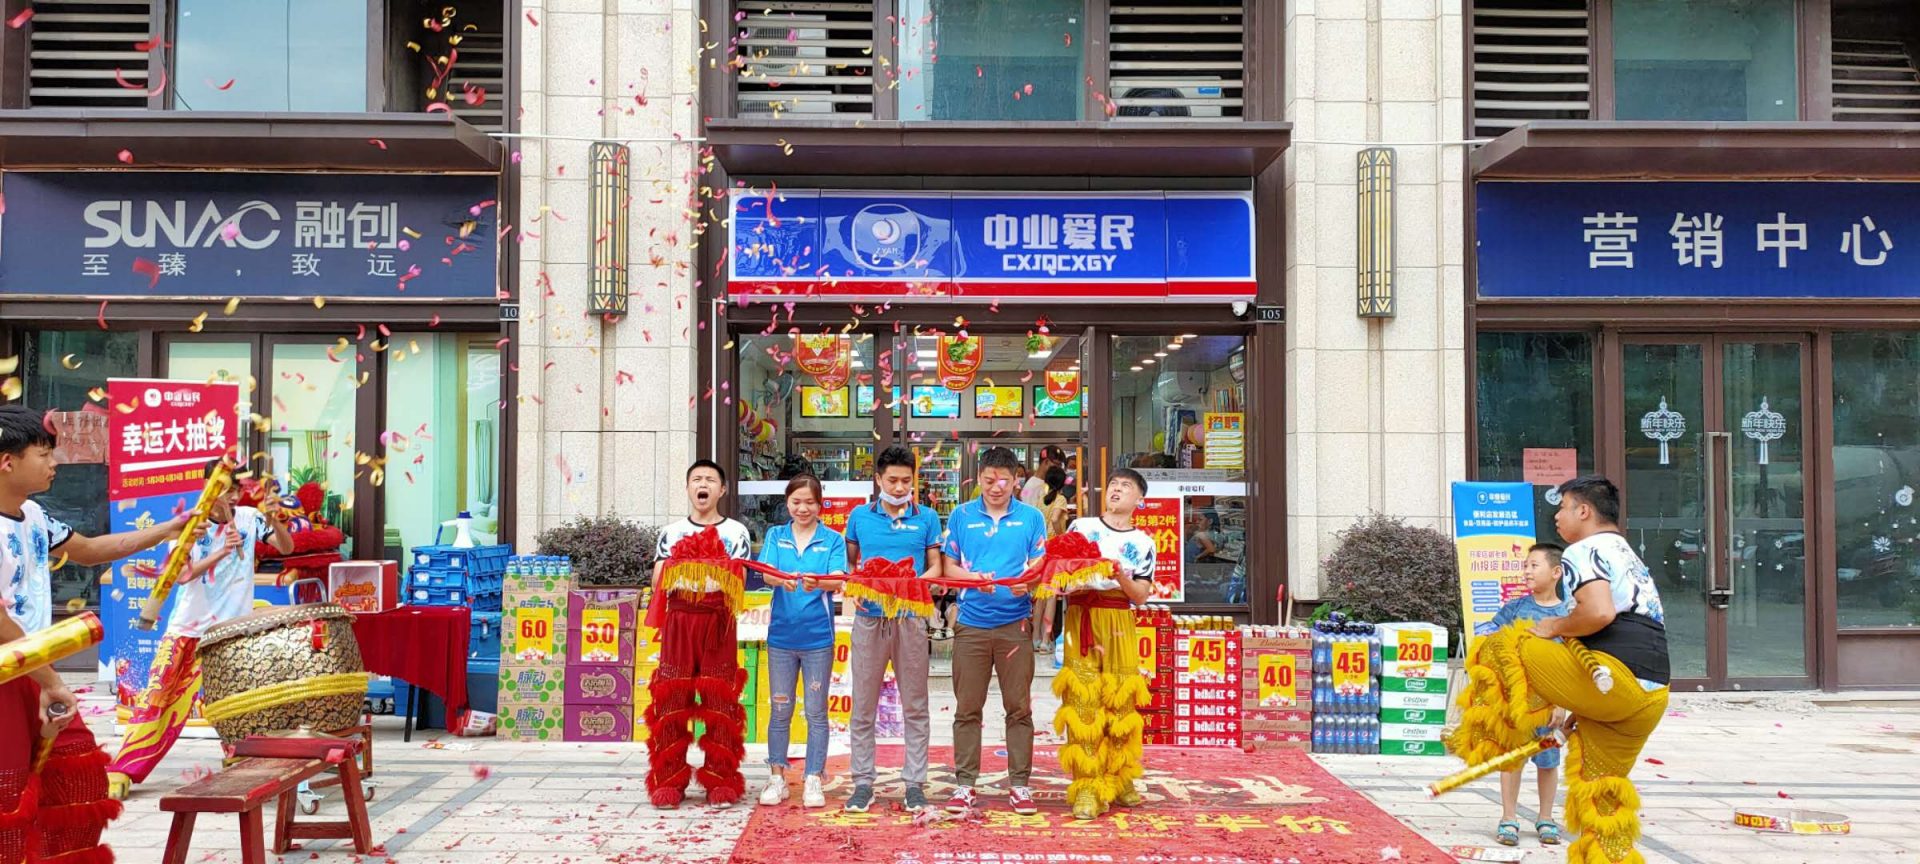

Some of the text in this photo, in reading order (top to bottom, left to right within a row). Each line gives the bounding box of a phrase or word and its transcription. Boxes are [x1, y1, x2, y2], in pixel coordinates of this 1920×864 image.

[83, 200, 398, 249] SUNAC 融创
[984, 213, 1135, 250] 中业爱民
[1582, 211, 1894, 269] 营销中心
[1002, 254, 1117, 276] CXJQCXGY
[504, 308, 518, 318] 10
[1261, 309, 1281, 320] 105
[1641, 418, 1686, 429] 新年快乐
[1741, 418, 1786, 429] 新年快乐
[122, 415, 226, 456] 幸运大抽奖
[1130, 514, 1176, 527] 场第2件
[521, 620, 547, 638] 6.0
[585, 623, 615, 643] 3.0
[1138, 637, 1152, 658] 0
[1191, 640, 1222, 662] 4.5
[1398, 643, 1432, 661] 23.0
[1336, 652, 1366, 673] 4.5
[518, 671, 546, 686] 脉动
[1263, 666, 1292, 687] 4.0
[516, 708, 545, 723] 脉动
